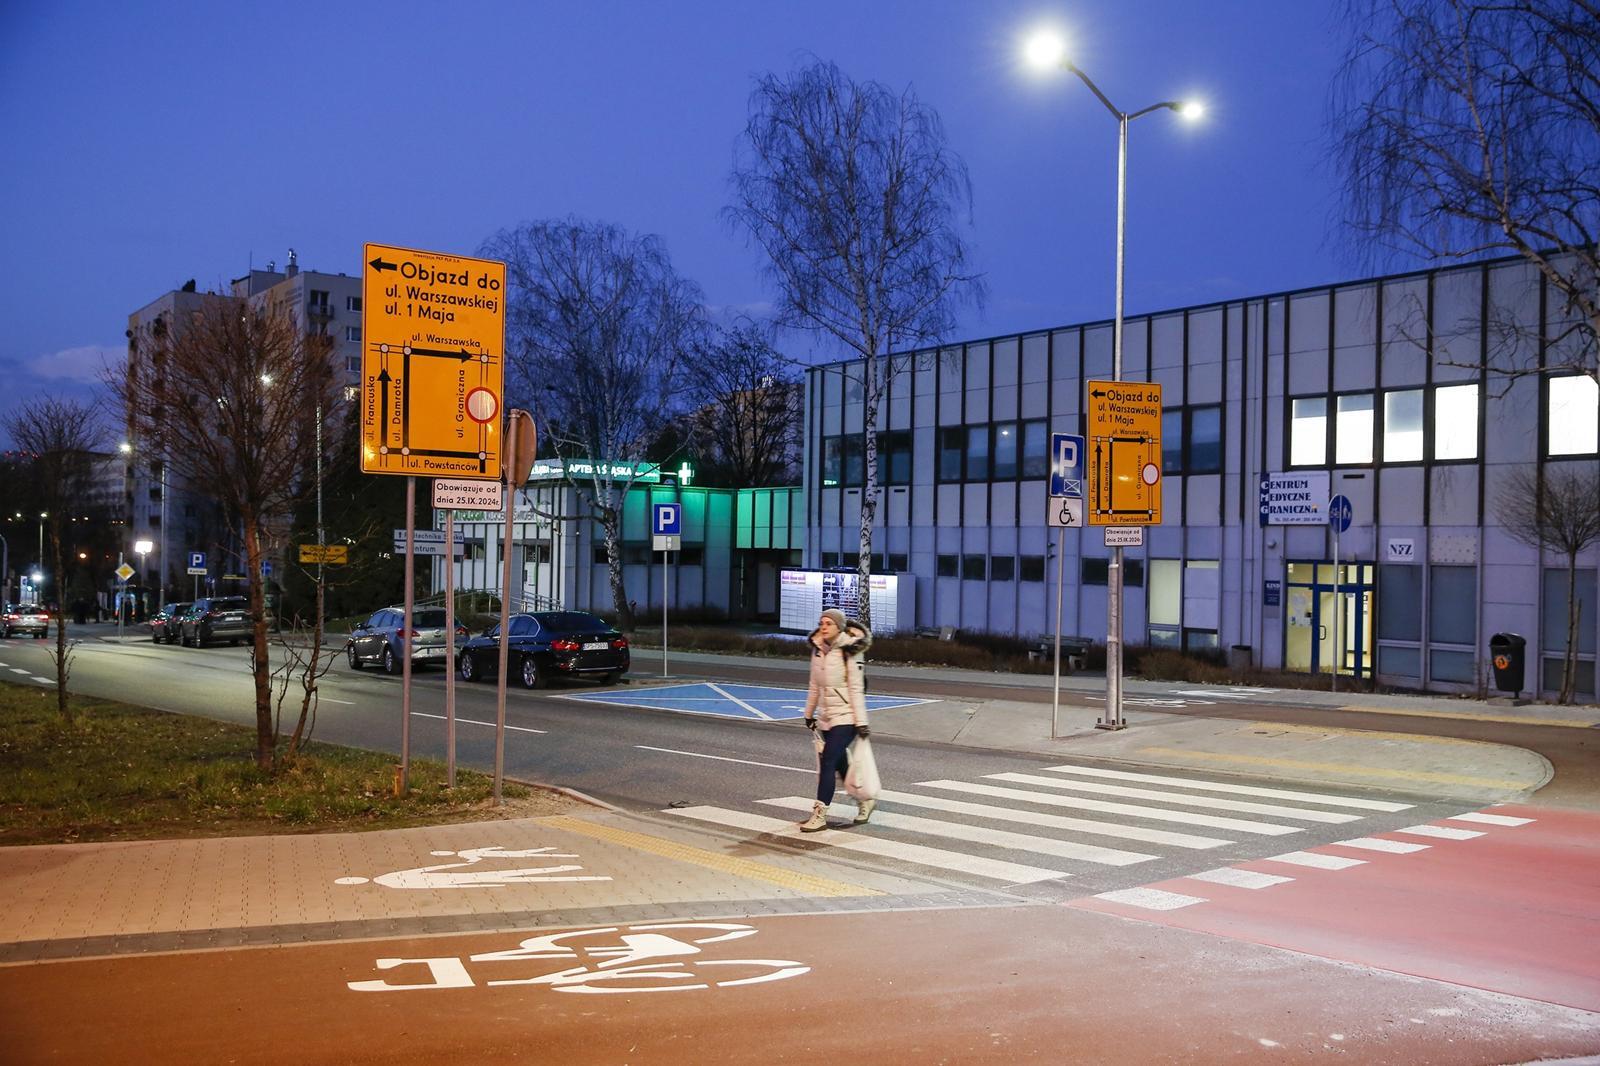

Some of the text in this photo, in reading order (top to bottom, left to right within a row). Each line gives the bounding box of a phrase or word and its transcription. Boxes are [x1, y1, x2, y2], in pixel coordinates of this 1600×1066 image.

[400, 262, 500, 290] Objazd do
[386, 286, 498, 314] ul. Warszawskiej
[385, 303, 454, 324] ul. 1 Maja
[412, 332, 480, 348] ul. Warszawska
[366, 376, 375, 426] Francuska
[392, 378, 401, 422] Damrota
[456, 370, 464, 424] Graniczna
[1106, 390, 1159, 402] Objazd do
[1098, 403, 1158, 416] ul. Warszawskiej
[1115, 416, 1134, 425] Maja
[1060, 440, 1077, 477] P
[410, 459, 478, 472] ul. Powstańców
[602, 464, 632, 477] ŚĄSKA
[436, 483, 483, 494] Obowiązuje
[1260, 480, 1308, 490] CENTRUM
[456, 496, 500, 506] 25.IX.2024r.
[1260, 493, 1311, 502] MEDYCZNE
[658, 507, 674, 531] P
[1390, 544, 1412, 555] NFZ
[192, 554, 202, 566] P
